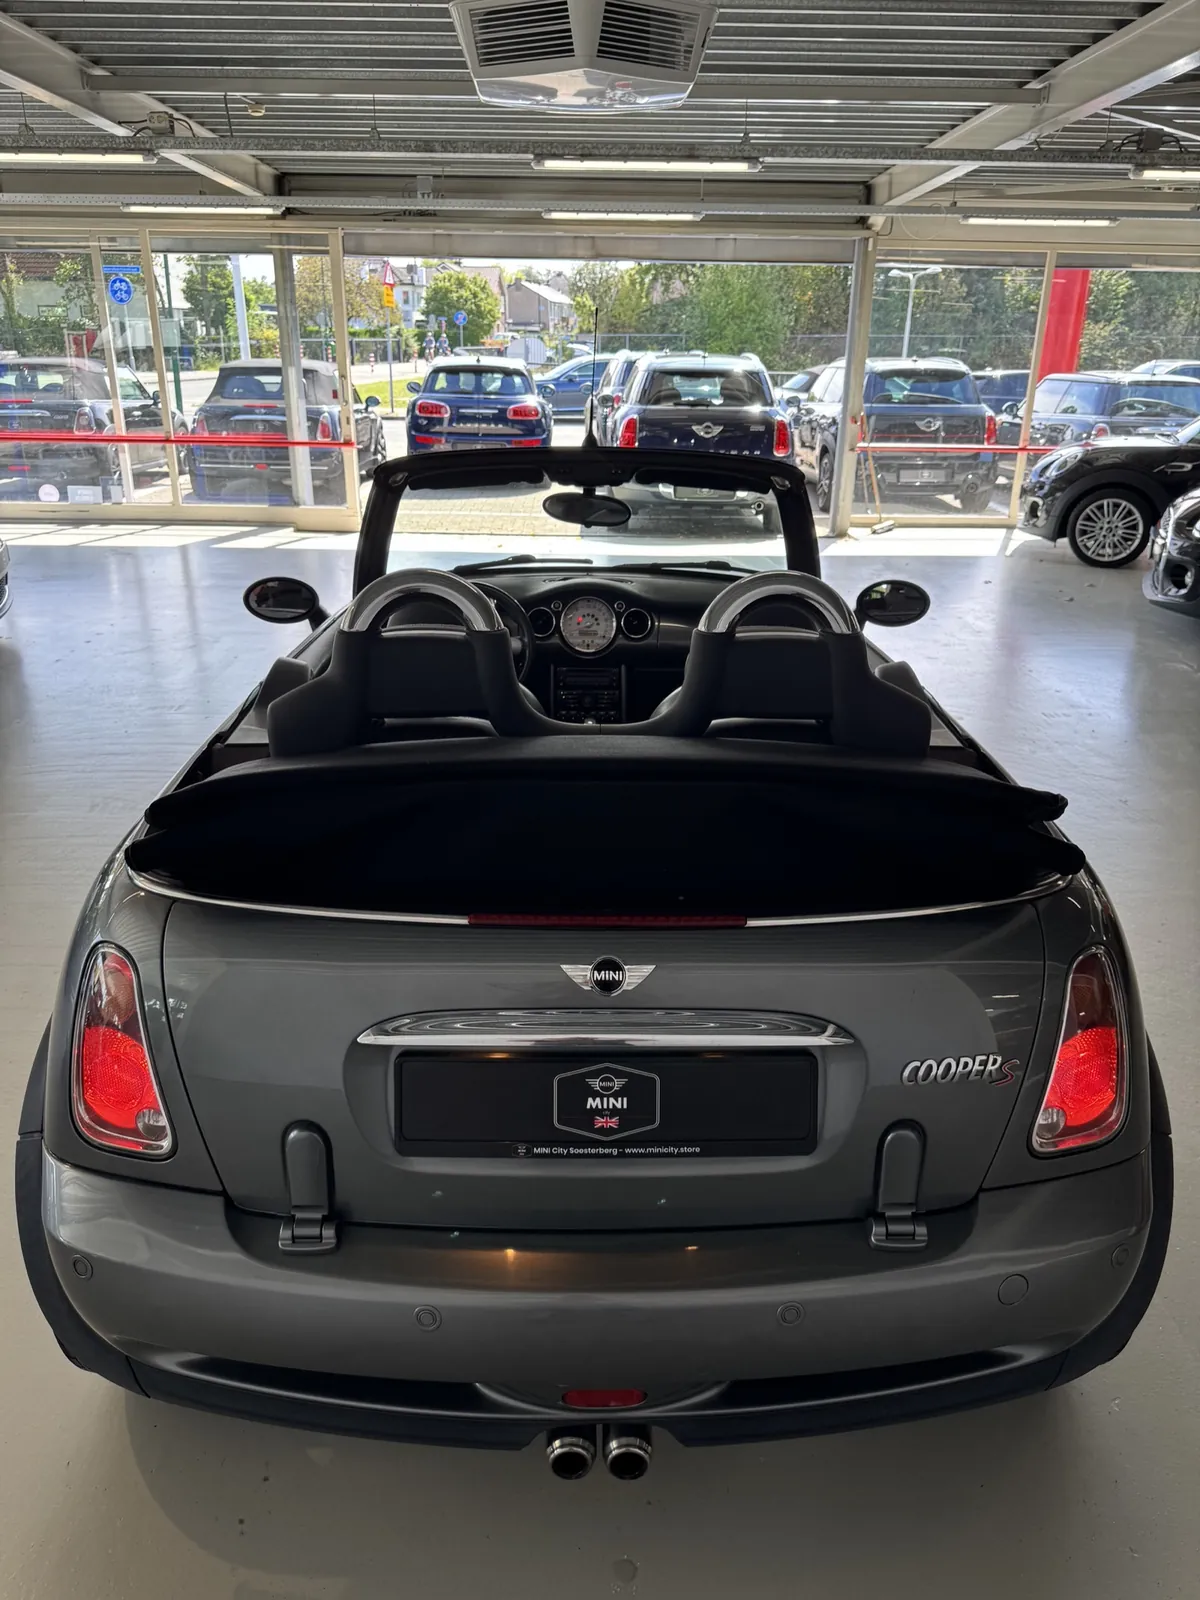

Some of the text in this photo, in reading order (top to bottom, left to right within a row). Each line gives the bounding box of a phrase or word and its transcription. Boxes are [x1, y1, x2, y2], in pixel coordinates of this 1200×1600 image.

[593, 970, 623, 981] MINI
[901, 1054, 1020, 1086] COOPER S
[586, 1096, 628, 1109] MINI
[533, 1146, 551, 1154] MINI
[551, 1146, 568, 1156] City
[569, 1146, 618, 1156] Soesterberg
[624, 1145, 701, 1155] www.minicity.store
